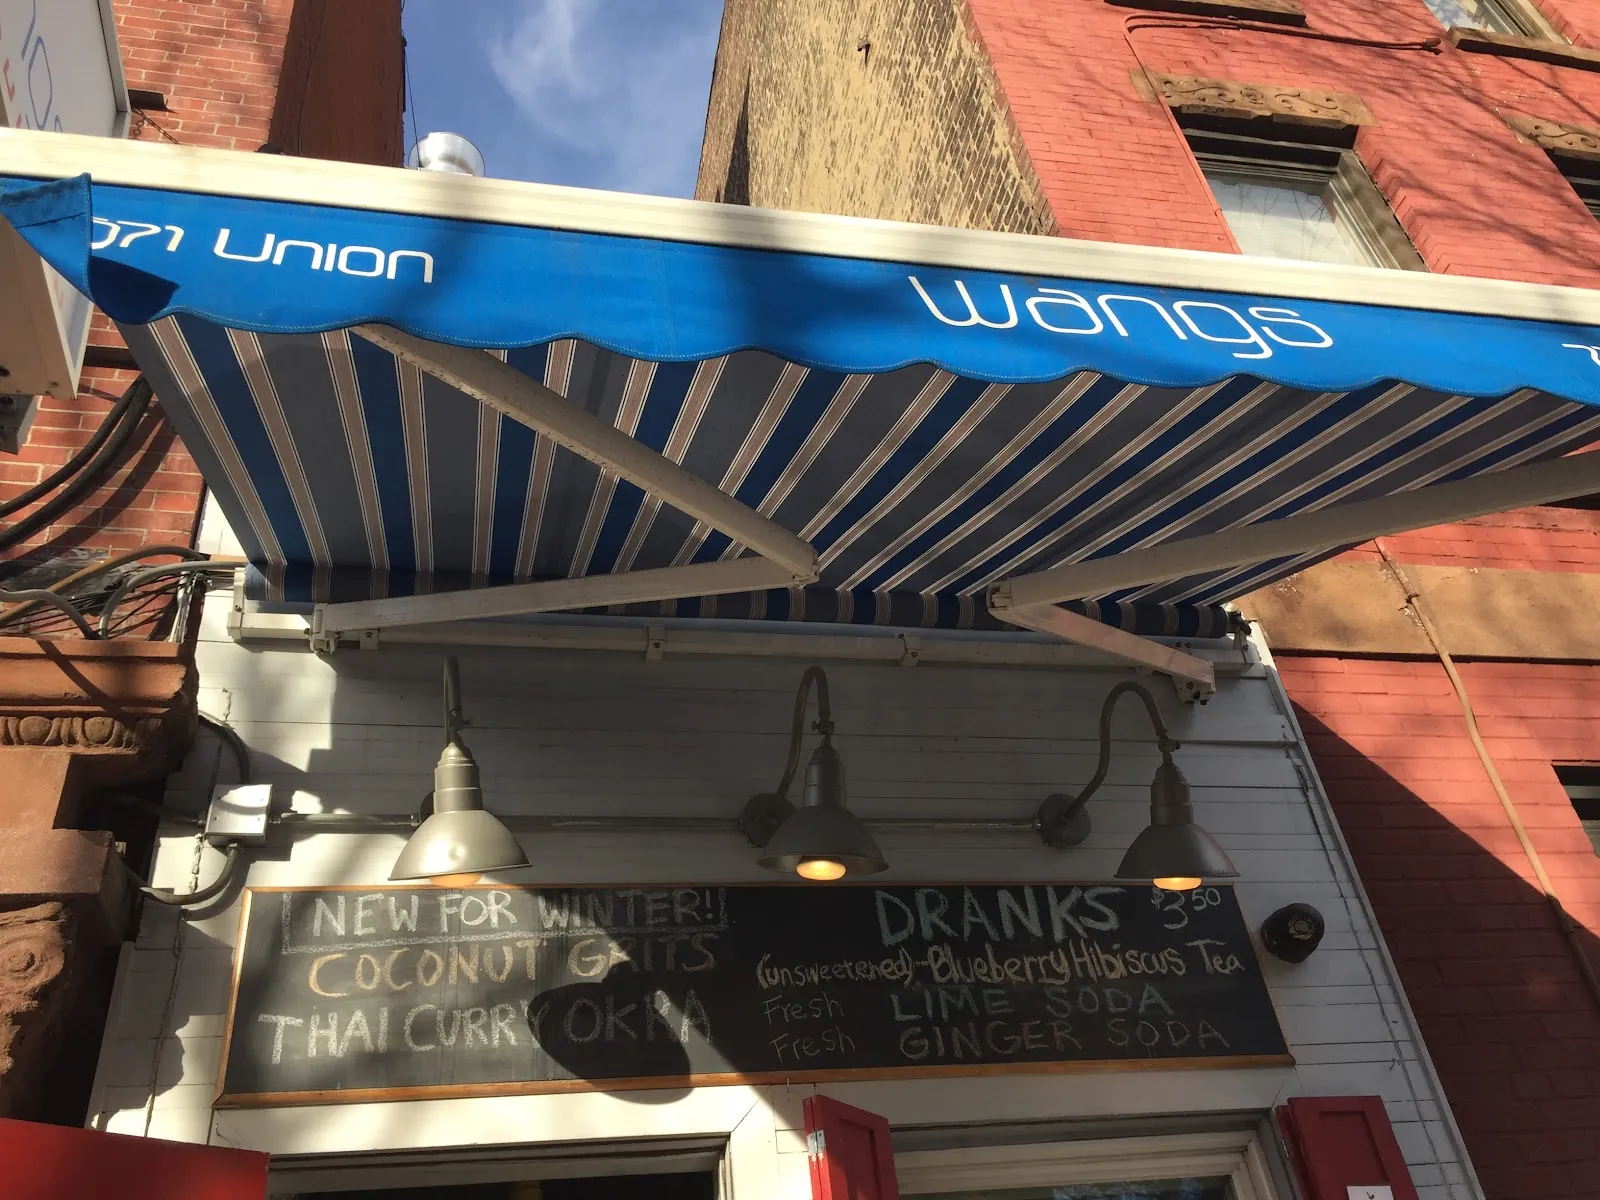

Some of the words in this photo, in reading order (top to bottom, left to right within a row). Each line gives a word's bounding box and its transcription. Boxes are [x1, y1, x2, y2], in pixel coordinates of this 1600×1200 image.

[312, 893, 420, 937] NEW
[437, 890, 518, 933] FOR
[537, 888, 715, 930] WINTER!
[874, 884, 1126, 947] DRANKS
[308, 939, 543, 998] COCONUT
[568, 933, 720, 977] GRITS
[1184, 938, 1246, 975] Tea
[258, 1005, 389, 1065] THAI
[403, 1000, 551, 1052] CURRY
[564, 985, 714, 1045] OKRA
[762, 991, 845, 1025] Fresh
[889, 985, 1015, 1023] LIME
[1043, 982, 1176, 1019] SODA
[769, 1025, 856, 1064] Fresh
[900, 1019, 1084, 1061] GINGER
[1106, 1014, 1231, 1050] SODA
